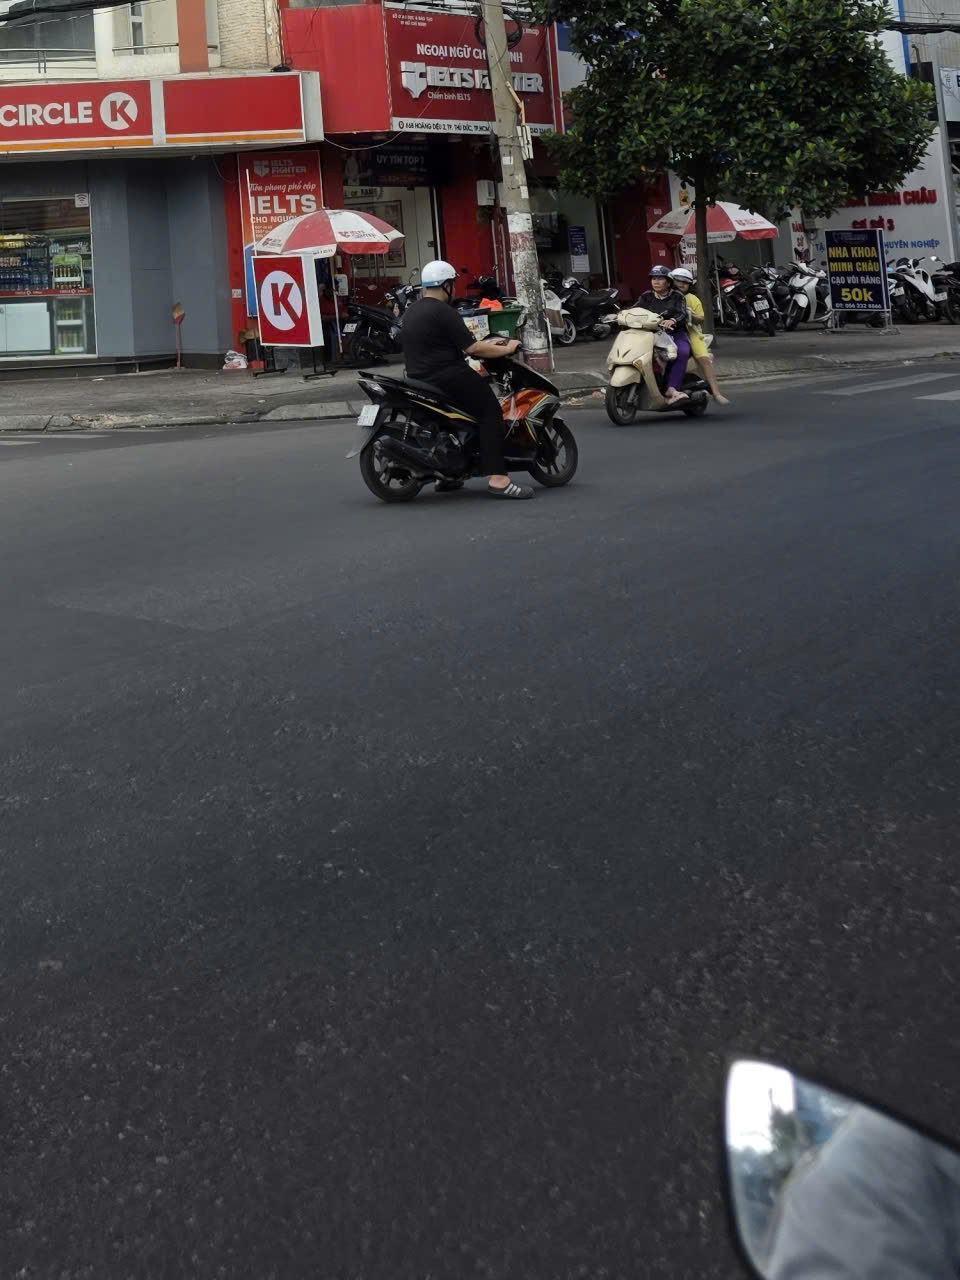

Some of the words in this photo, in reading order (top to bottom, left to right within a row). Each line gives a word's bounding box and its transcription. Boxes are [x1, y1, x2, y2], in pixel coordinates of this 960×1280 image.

[416, 43, 447, 60] NGOẠI
[449, 44, 471, 58] NGỮ
[427, 65, 474, 89] IELTS
[457, 93, 471, 101] IELTS
[104, 95, 138, 129] K
[271, 166, 307, 174] FIGHTER
[264, 184, 286, 193] phong
[903, 187, 937, 206] CHÂU
[250, 194, 317, 215] IELTS
[884, 239, 909, 249] HUYÊN
[910, 238, 940, 251] NGHIỆP
[828, 247, 849, 258] NHA
[851, 247, 878, 258] KHOA
[829, 262, 853, 272] MINH
[856, 260, 880, 272] CHÂU
[831, 276, 846, 285] CẠO
[860, 275, 881, 284] RĂNG
[841, 287, 874, 302] 50k
[265, 277, 302, 329] K
